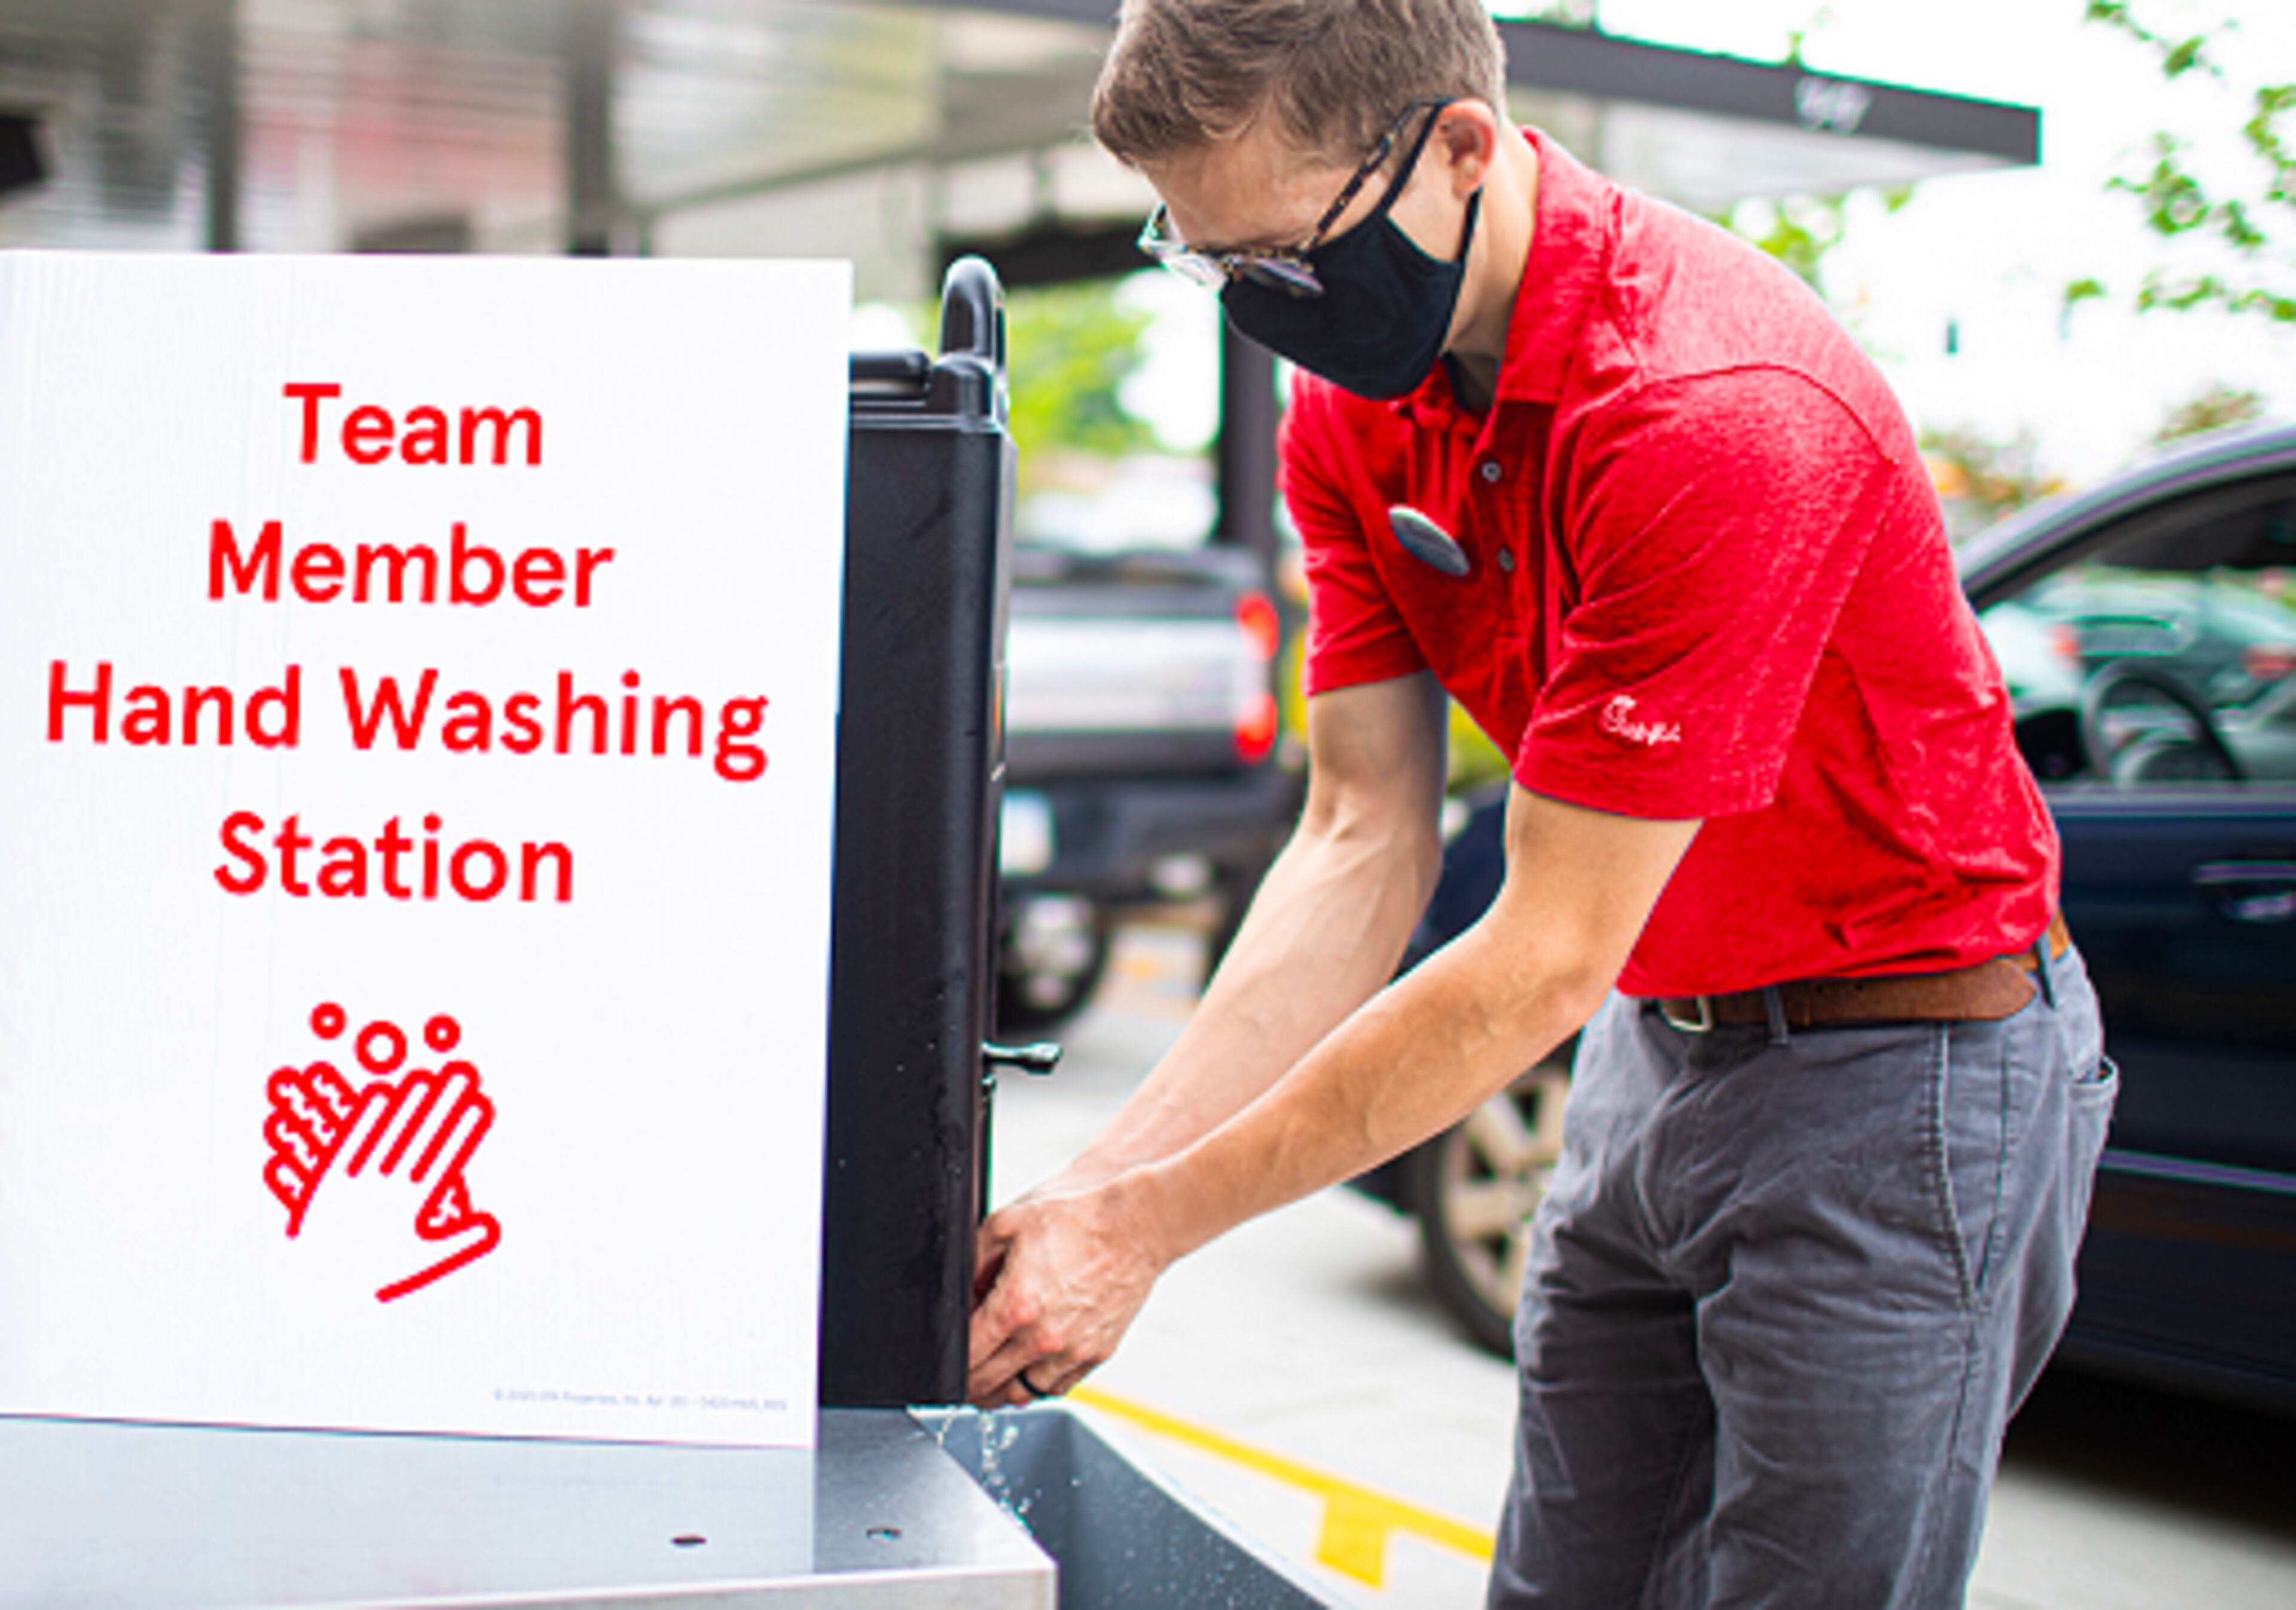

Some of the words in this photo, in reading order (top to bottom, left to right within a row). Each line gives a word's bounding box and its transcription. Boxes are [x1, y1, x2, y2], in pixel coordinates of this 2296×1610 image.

[283, 383, 542, 465] Team
[209, 520, 615, 607] Member
[47, 660, 301, 749] Hand
[339, 667, 768, 782] Washing
[214, 811, 572, 902] Station
